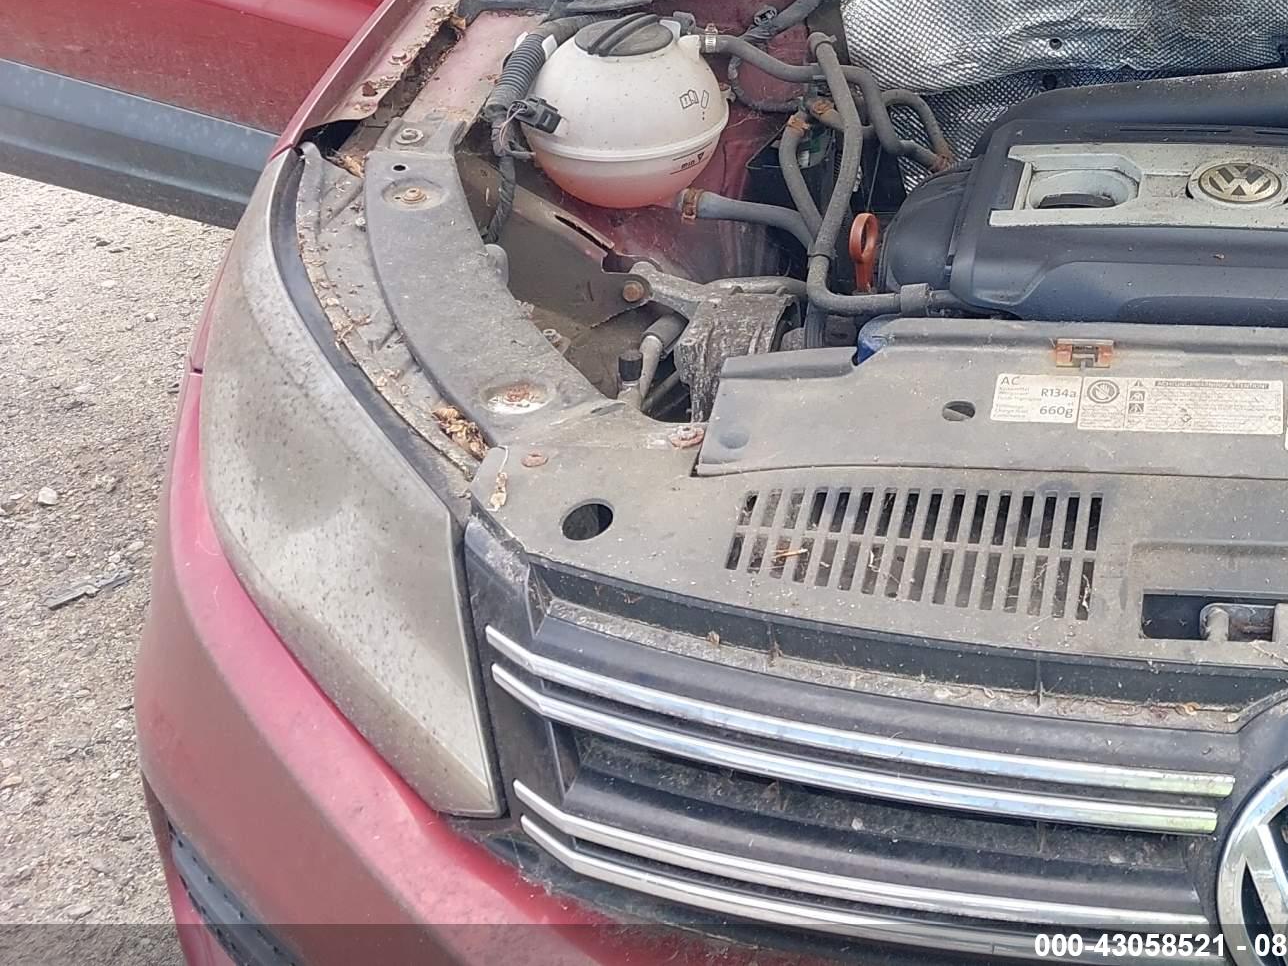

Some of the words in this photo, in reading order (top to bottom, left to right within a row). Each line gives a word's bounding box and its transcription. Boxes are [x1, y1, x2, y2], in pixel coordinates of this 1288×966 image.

[1000, 376, 1020, 386] AC
[1041, 388, 1077, 398] R134a
[1040, 406, 1073, 418] 660g
